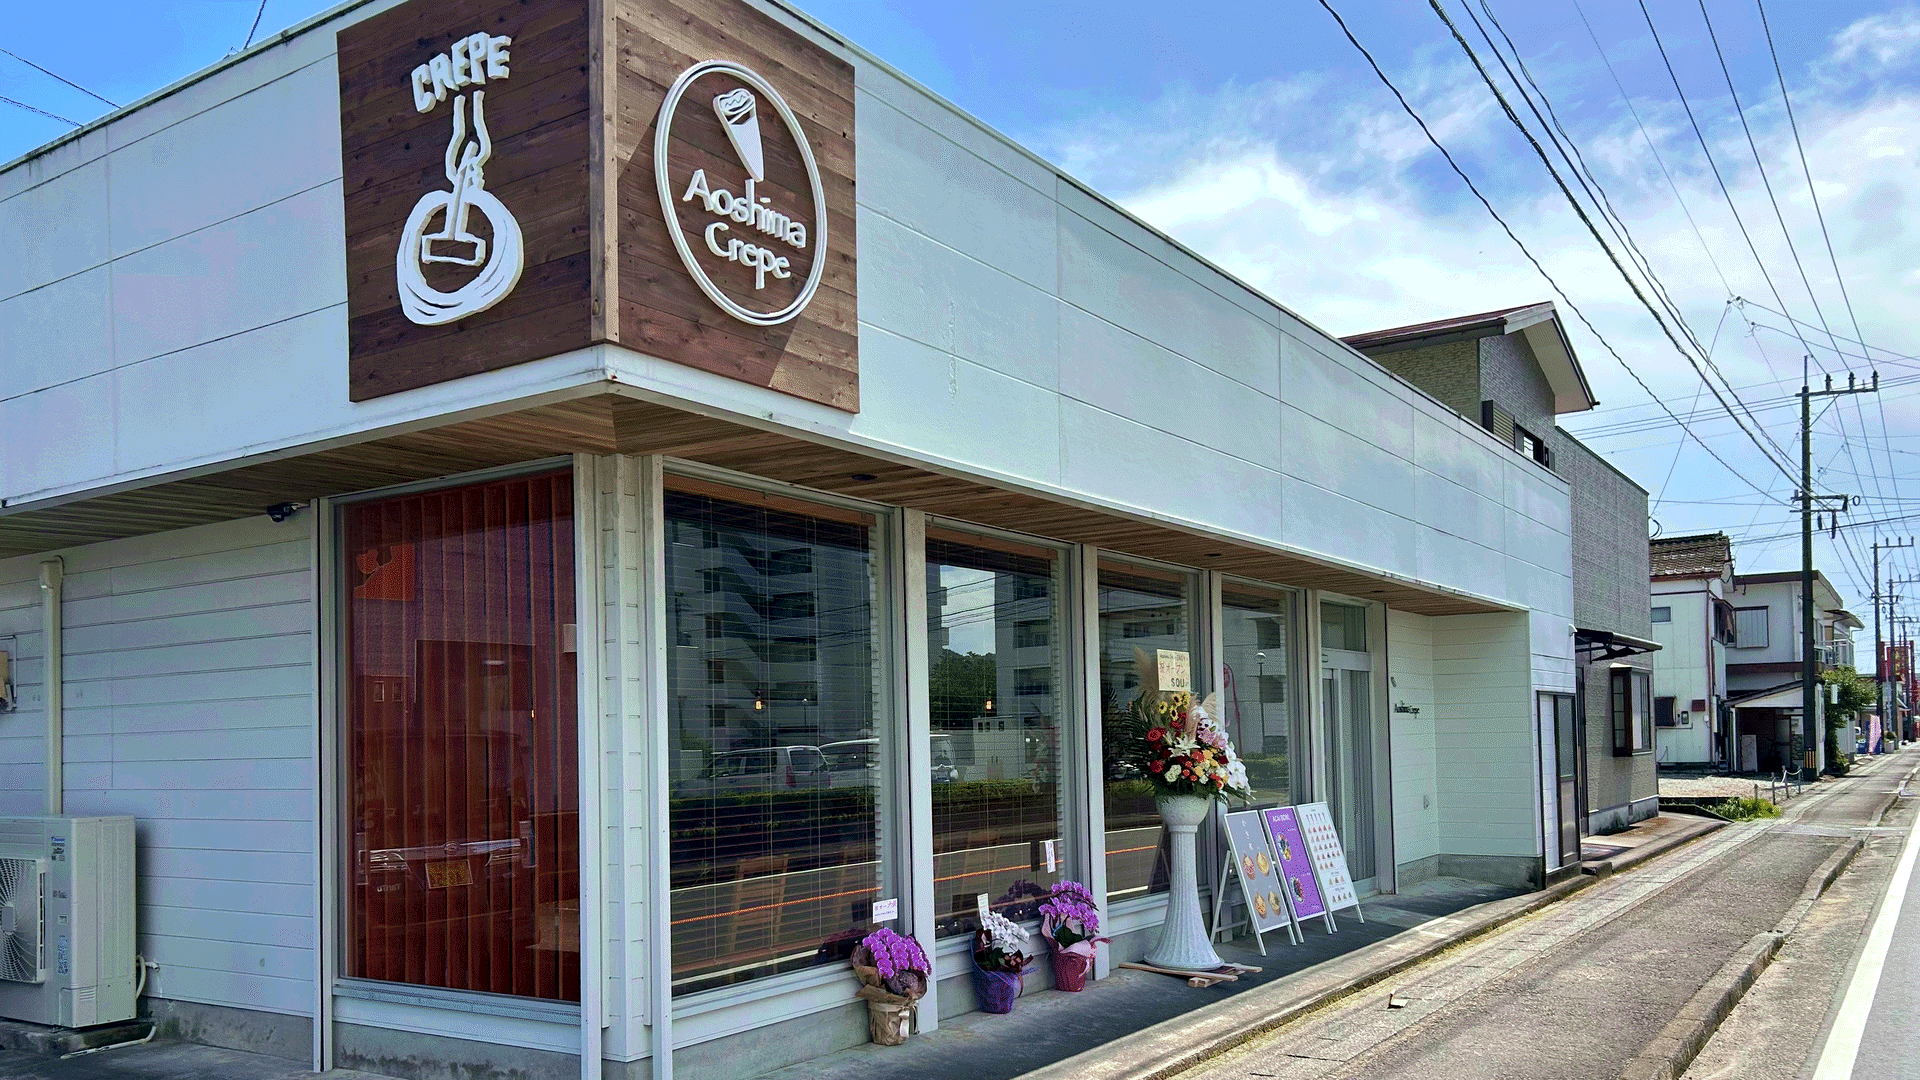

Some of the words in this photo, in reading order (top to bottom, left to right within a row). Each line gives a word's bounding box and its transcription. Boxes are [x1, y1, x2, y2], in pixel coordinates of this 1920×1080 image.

[411, 31, 512, 114] CREPE
[682, 168, 807, 249] Aoshima
[704, 222, 791, 290] Crepe
[1170, 677, 1185, 688] SOU
